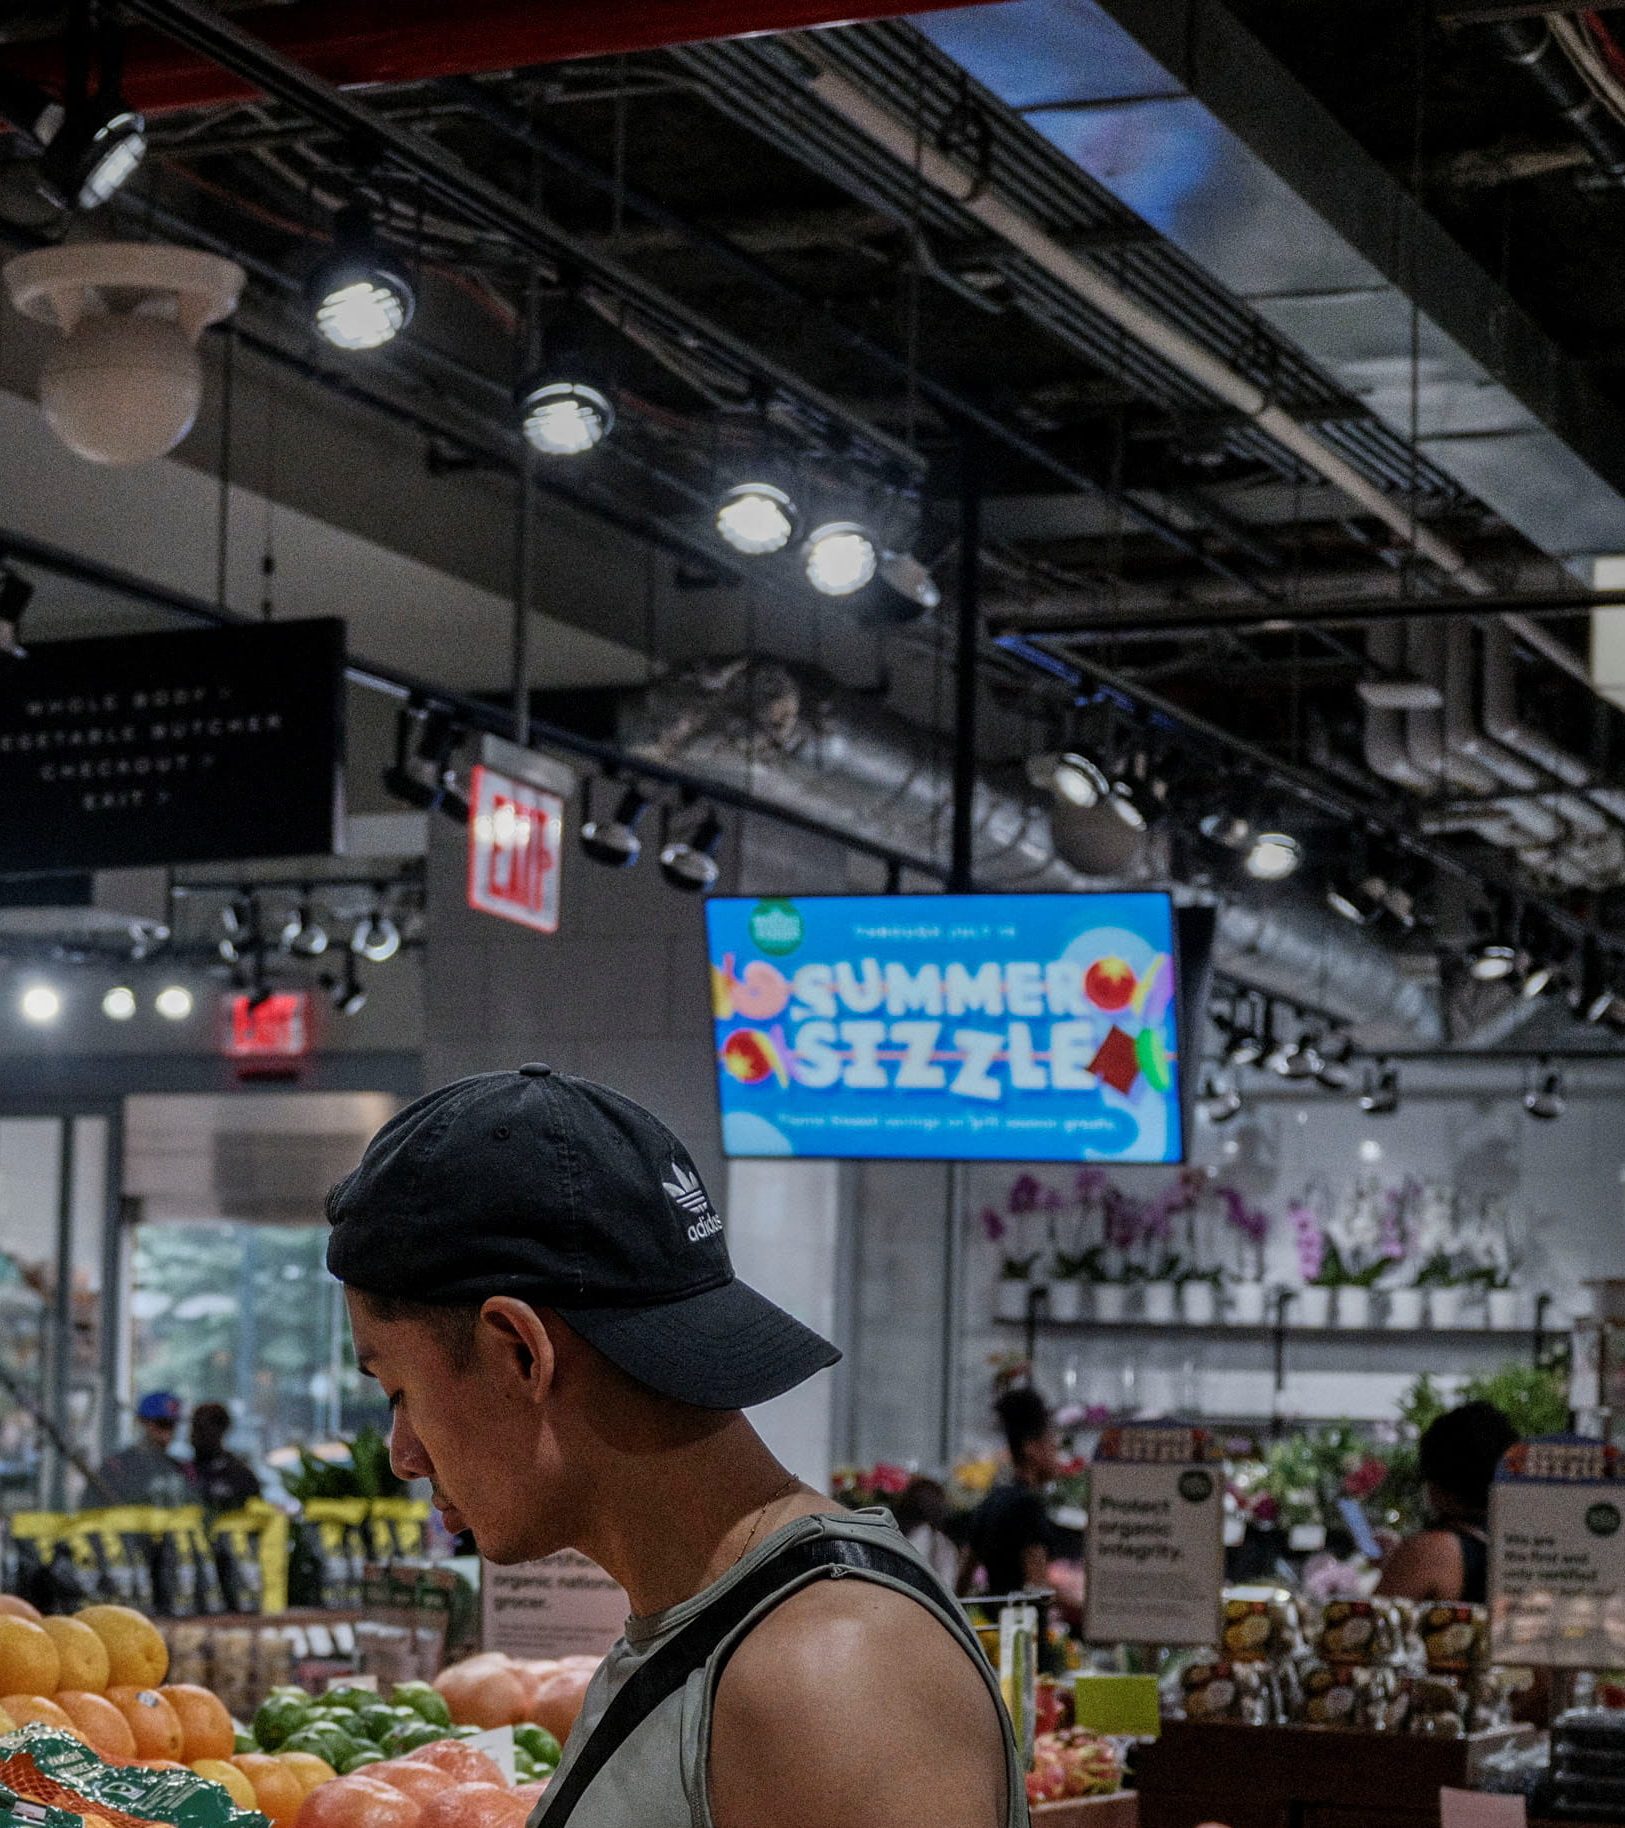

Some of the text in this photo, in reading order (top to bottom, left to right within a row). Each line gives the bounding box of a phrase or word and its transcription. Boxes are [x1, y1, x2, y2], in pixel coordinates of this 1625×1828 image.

[789, 956, 1096, 1024] SUMMER
[792, 1020, 1099, 1104] SIZZLE
[686, 1213, 724, 1243] adidas
